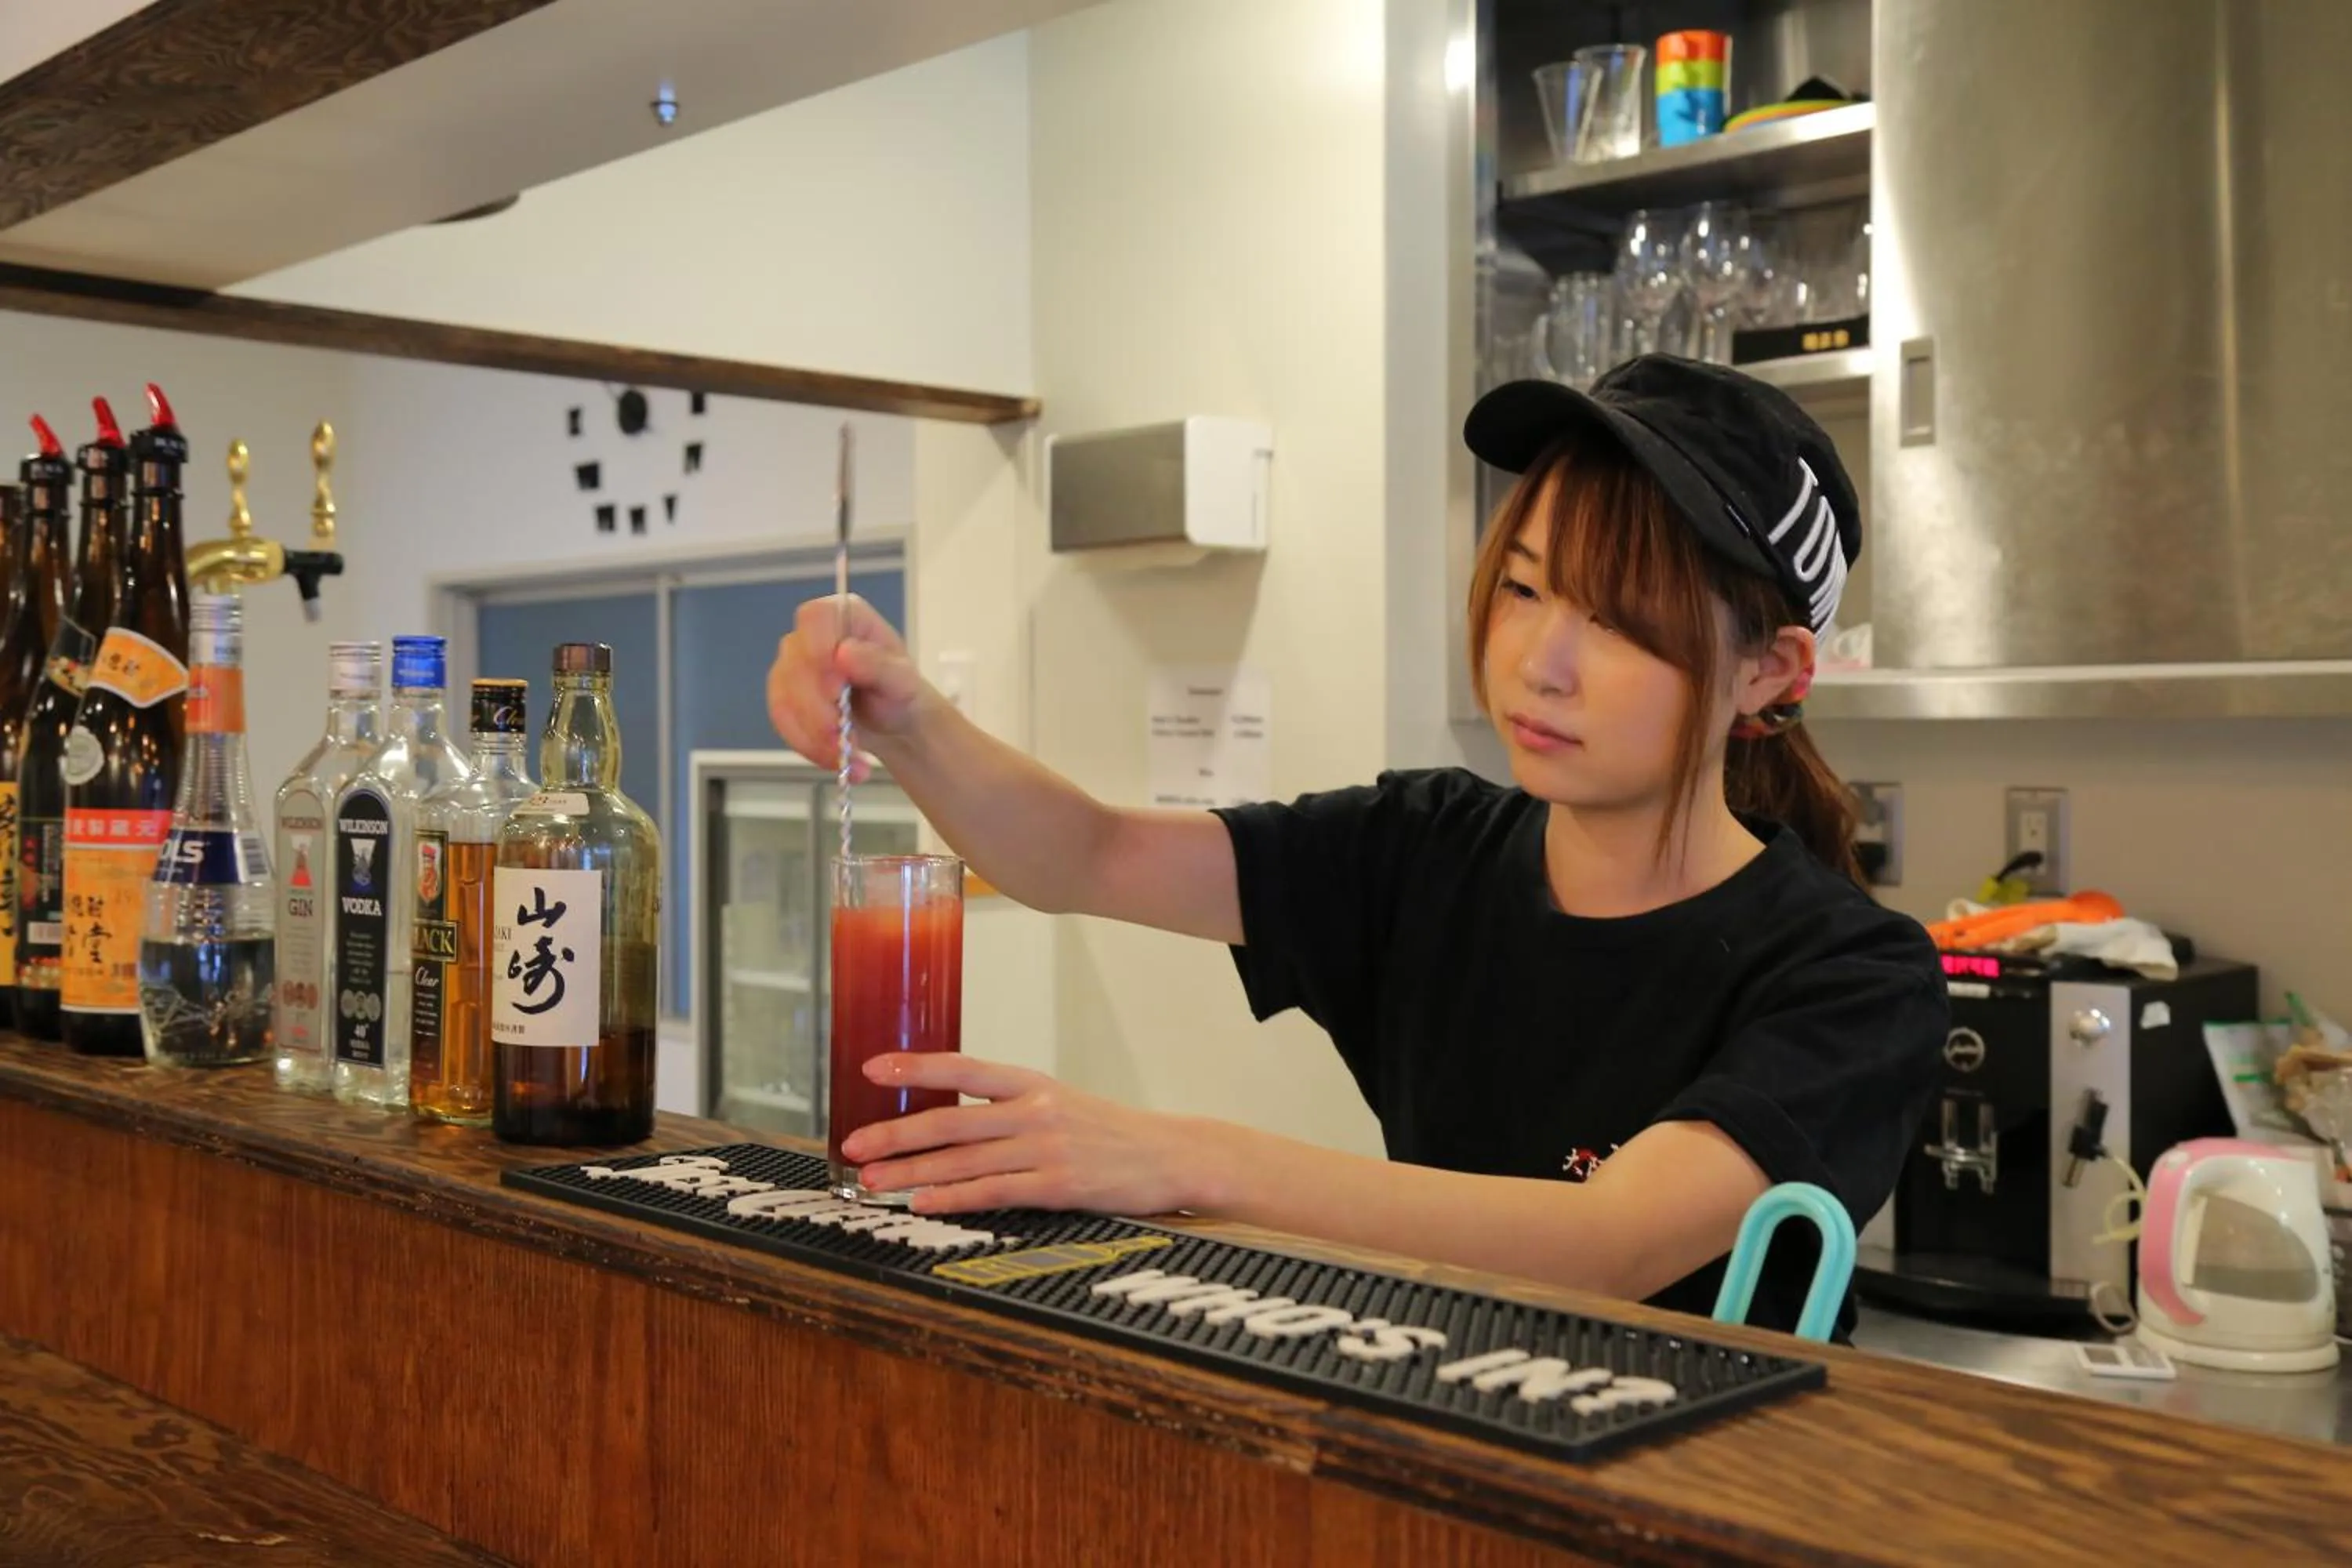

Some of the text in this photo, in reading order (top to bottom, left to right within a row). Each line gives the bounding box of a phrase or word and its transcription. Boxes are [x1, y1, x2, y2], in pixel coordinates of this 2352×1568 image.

[339, 819, 389, 835] WILKINSON
[289, 898, 314, 917] GIN
[342, 897, 383, 916] VODKA
[415, 965, 440, 987] Clear
[1090, 1269, 1678, 1417] WHO'S IN?
